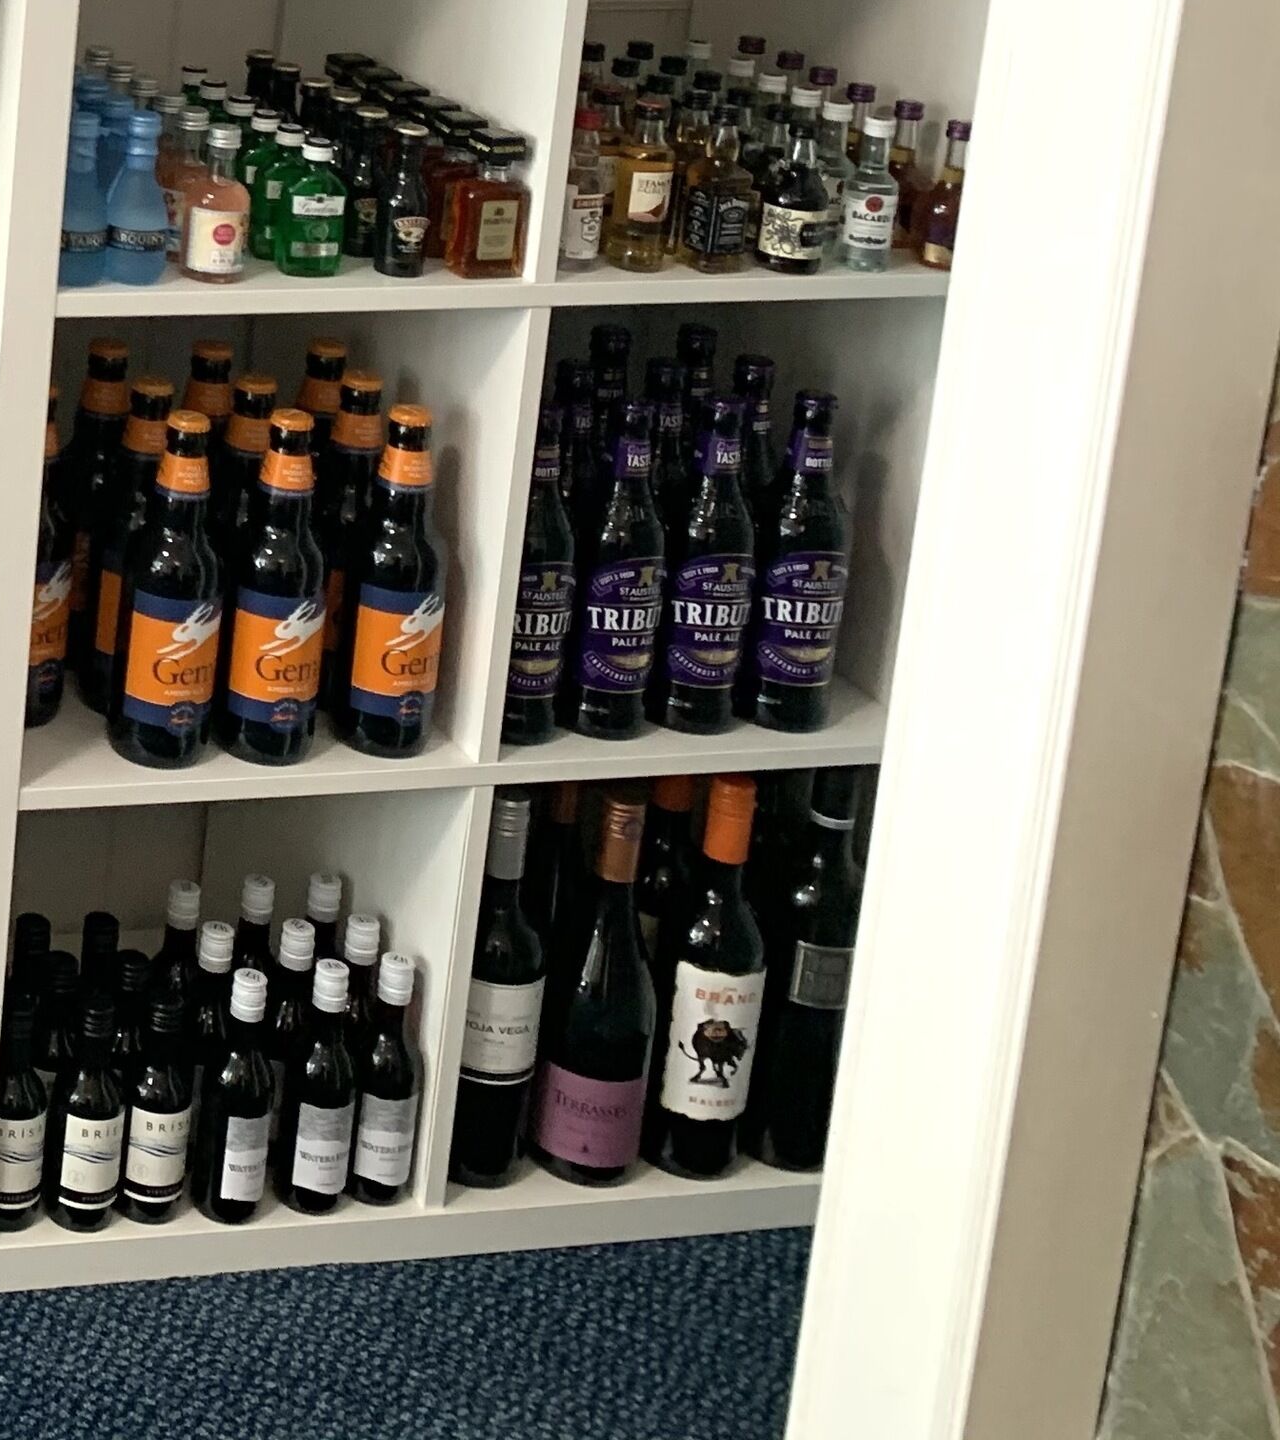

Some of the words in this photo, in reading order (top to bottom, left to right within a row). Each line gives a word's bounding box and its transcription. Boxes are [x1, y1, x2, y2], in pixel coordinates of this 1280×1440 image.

[694, 632, 720, 642] PALE
[785, 629, 811, 640] PALE
[515, 641, 541, 652] PALE
[612, 637, 637, 648] PALE
[499, 1025, 531, 1036] VEGA
